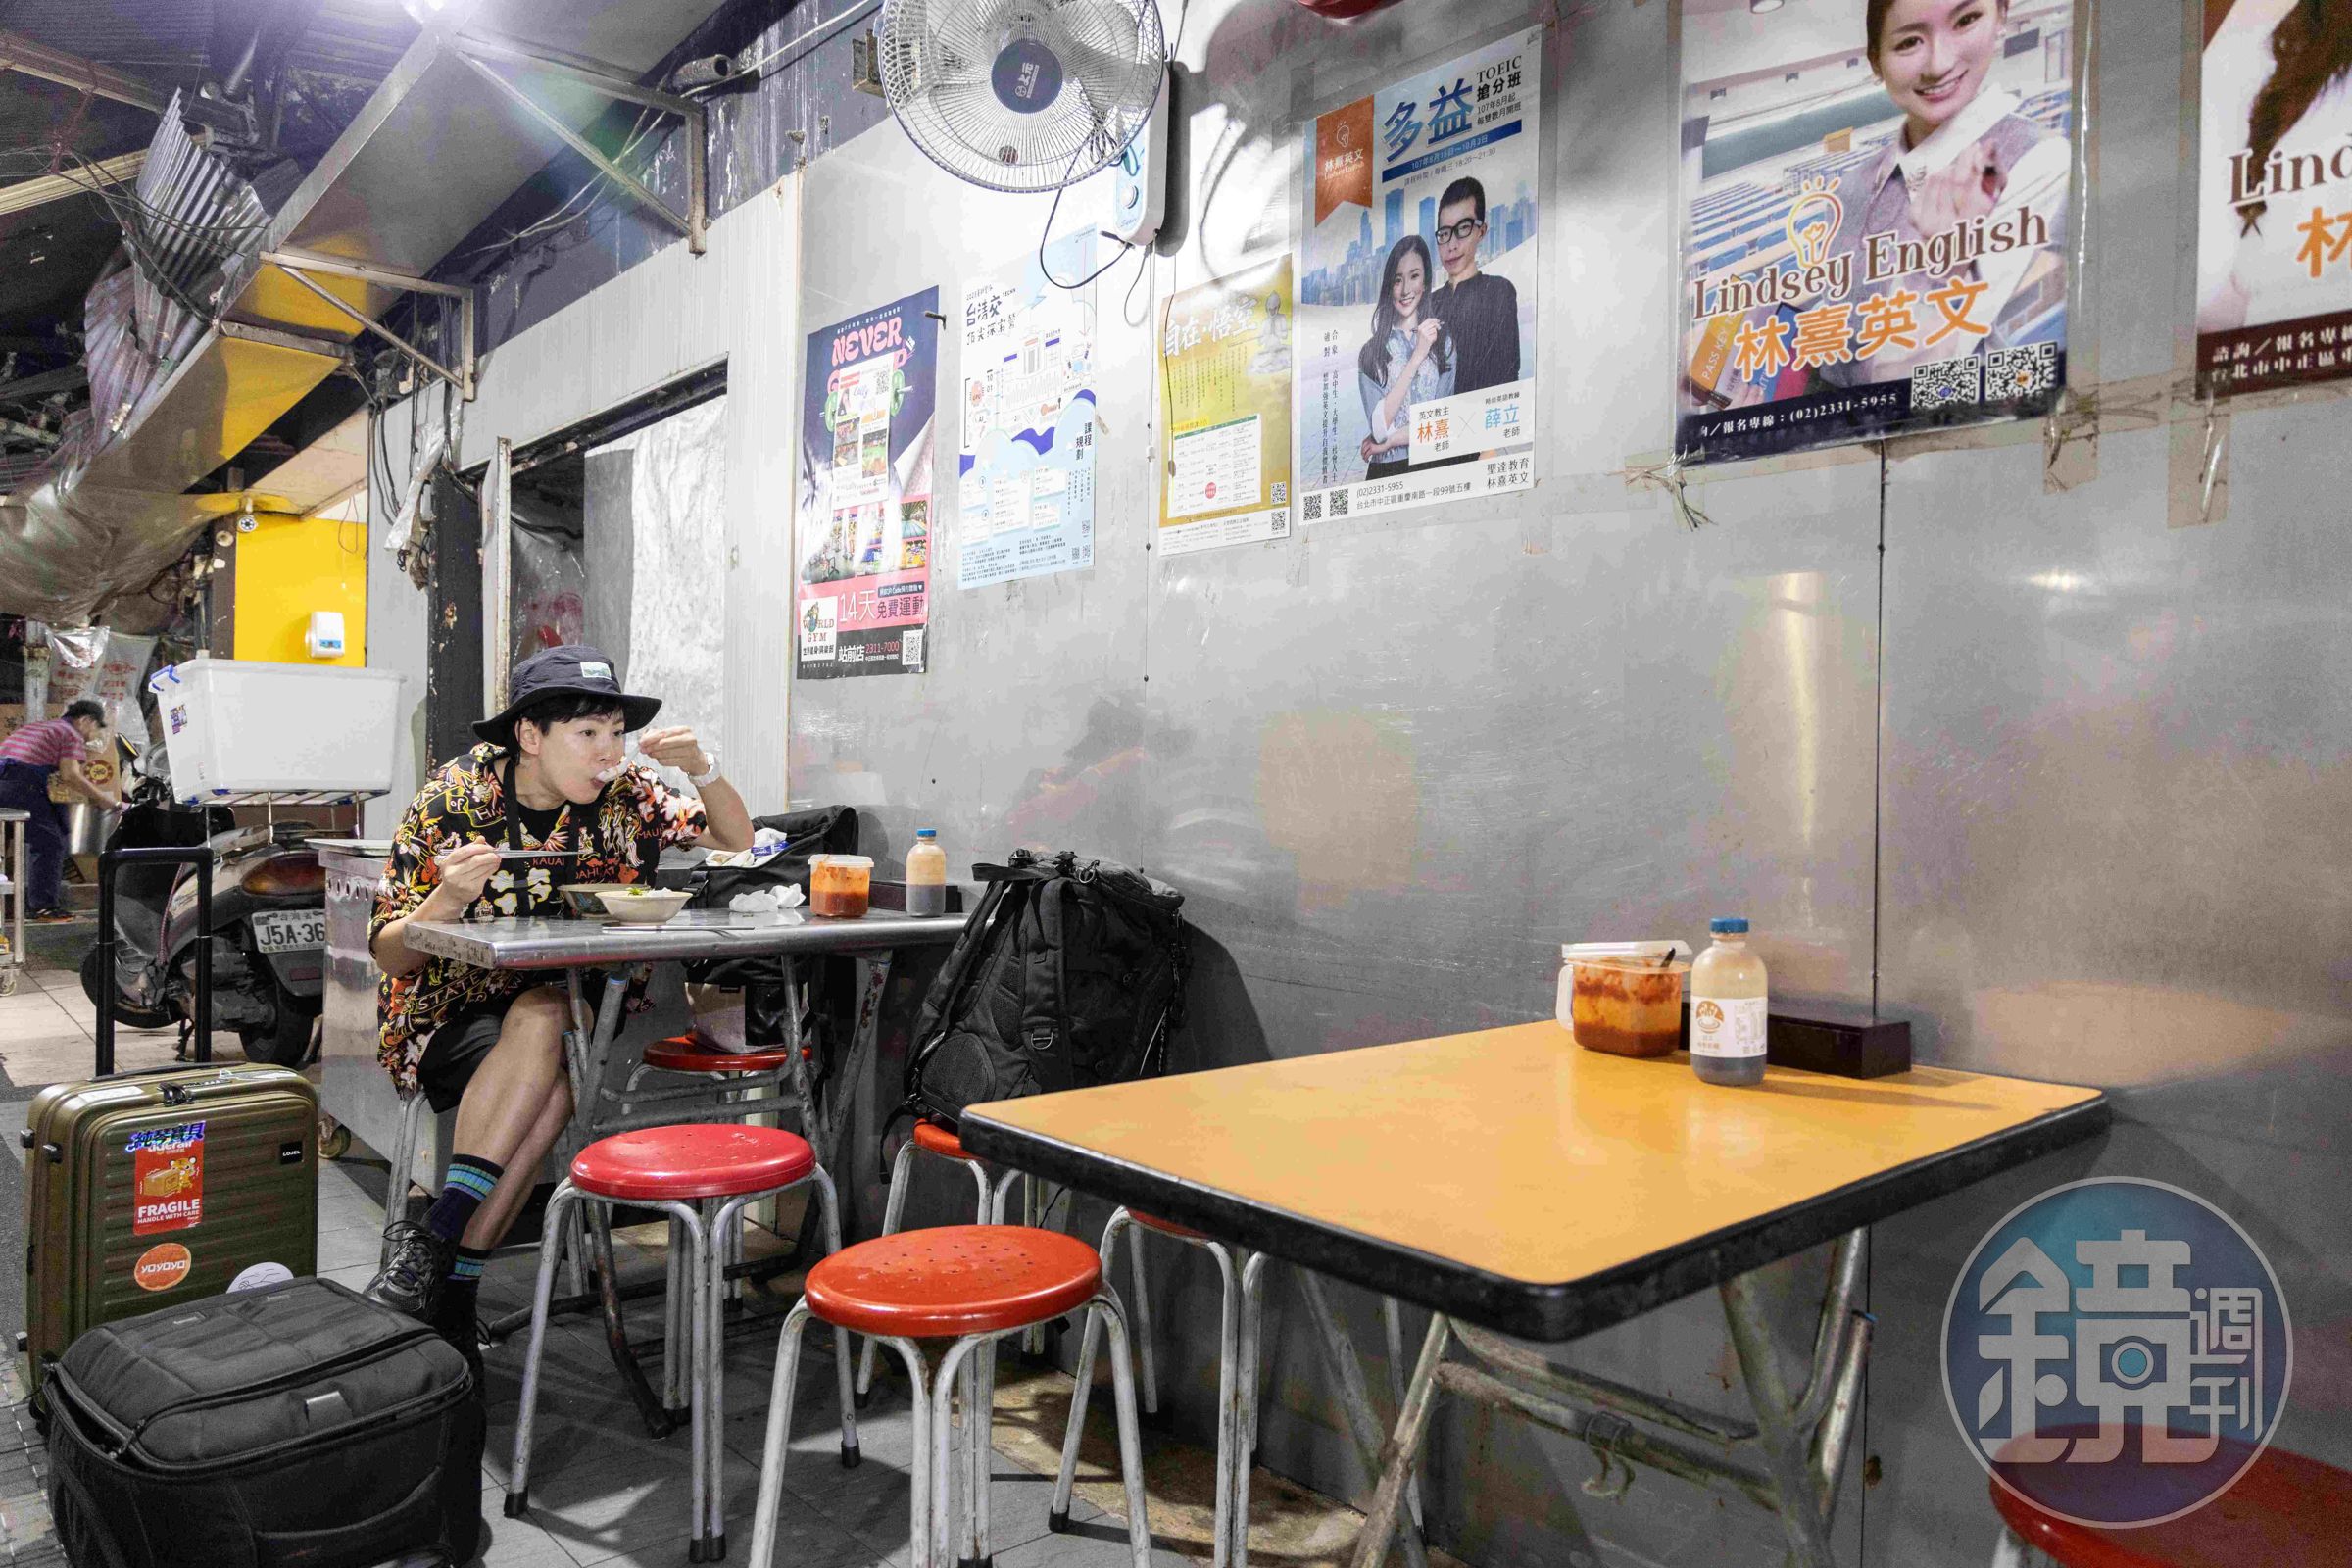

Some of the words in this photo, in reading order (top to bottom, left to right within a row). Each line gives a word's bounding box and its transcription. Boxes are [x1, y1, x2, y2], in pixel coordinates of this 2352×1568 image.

[1477, 56, 1522, 83] TOEIC
[1477, 71, 1521, 102] 搶分班
[1478, 93, 1516, 115] 107年8月起
[1382, 78, 1473, 162] 多益
[1693, 253, 1852, 319] Lindsey
[1864, 206, 2050, 281] English
[1735, 278, 1990, 382] 林熹英文
[831, 317, 903, 367] NEVER
[1702, 351, 1720, 380] PASS
[1419, 406, 1449, 420] 英文教主
[1485, 404, 1520, 430] 薛立
[1417, 418, 1449, 443] 林熹
[1503, 426, 1520, 438] 老師
[1434, 440, 1449, 452] 老師
[1356, 480, 1403, 499] (02)2331-5955
[1488, 471, 1529, 490] 林熹英文
[840, 589, 876, 622] 14天
[877, 595, 923, 619] 免費運動
[807, 632, 828, 642] GYM
[865, 640, 900, 654] 2311-7000
[838, 644, 864, 662] 站前店
[532, 858, 564, 867] KAUAI
[260, 923, 324, 945] J5A-36
[418, 973, 479, 1010] STATE
[138, 1199, 200, 1217] FRAGILE
[137, 1215, 164, 1224] HANDLE
